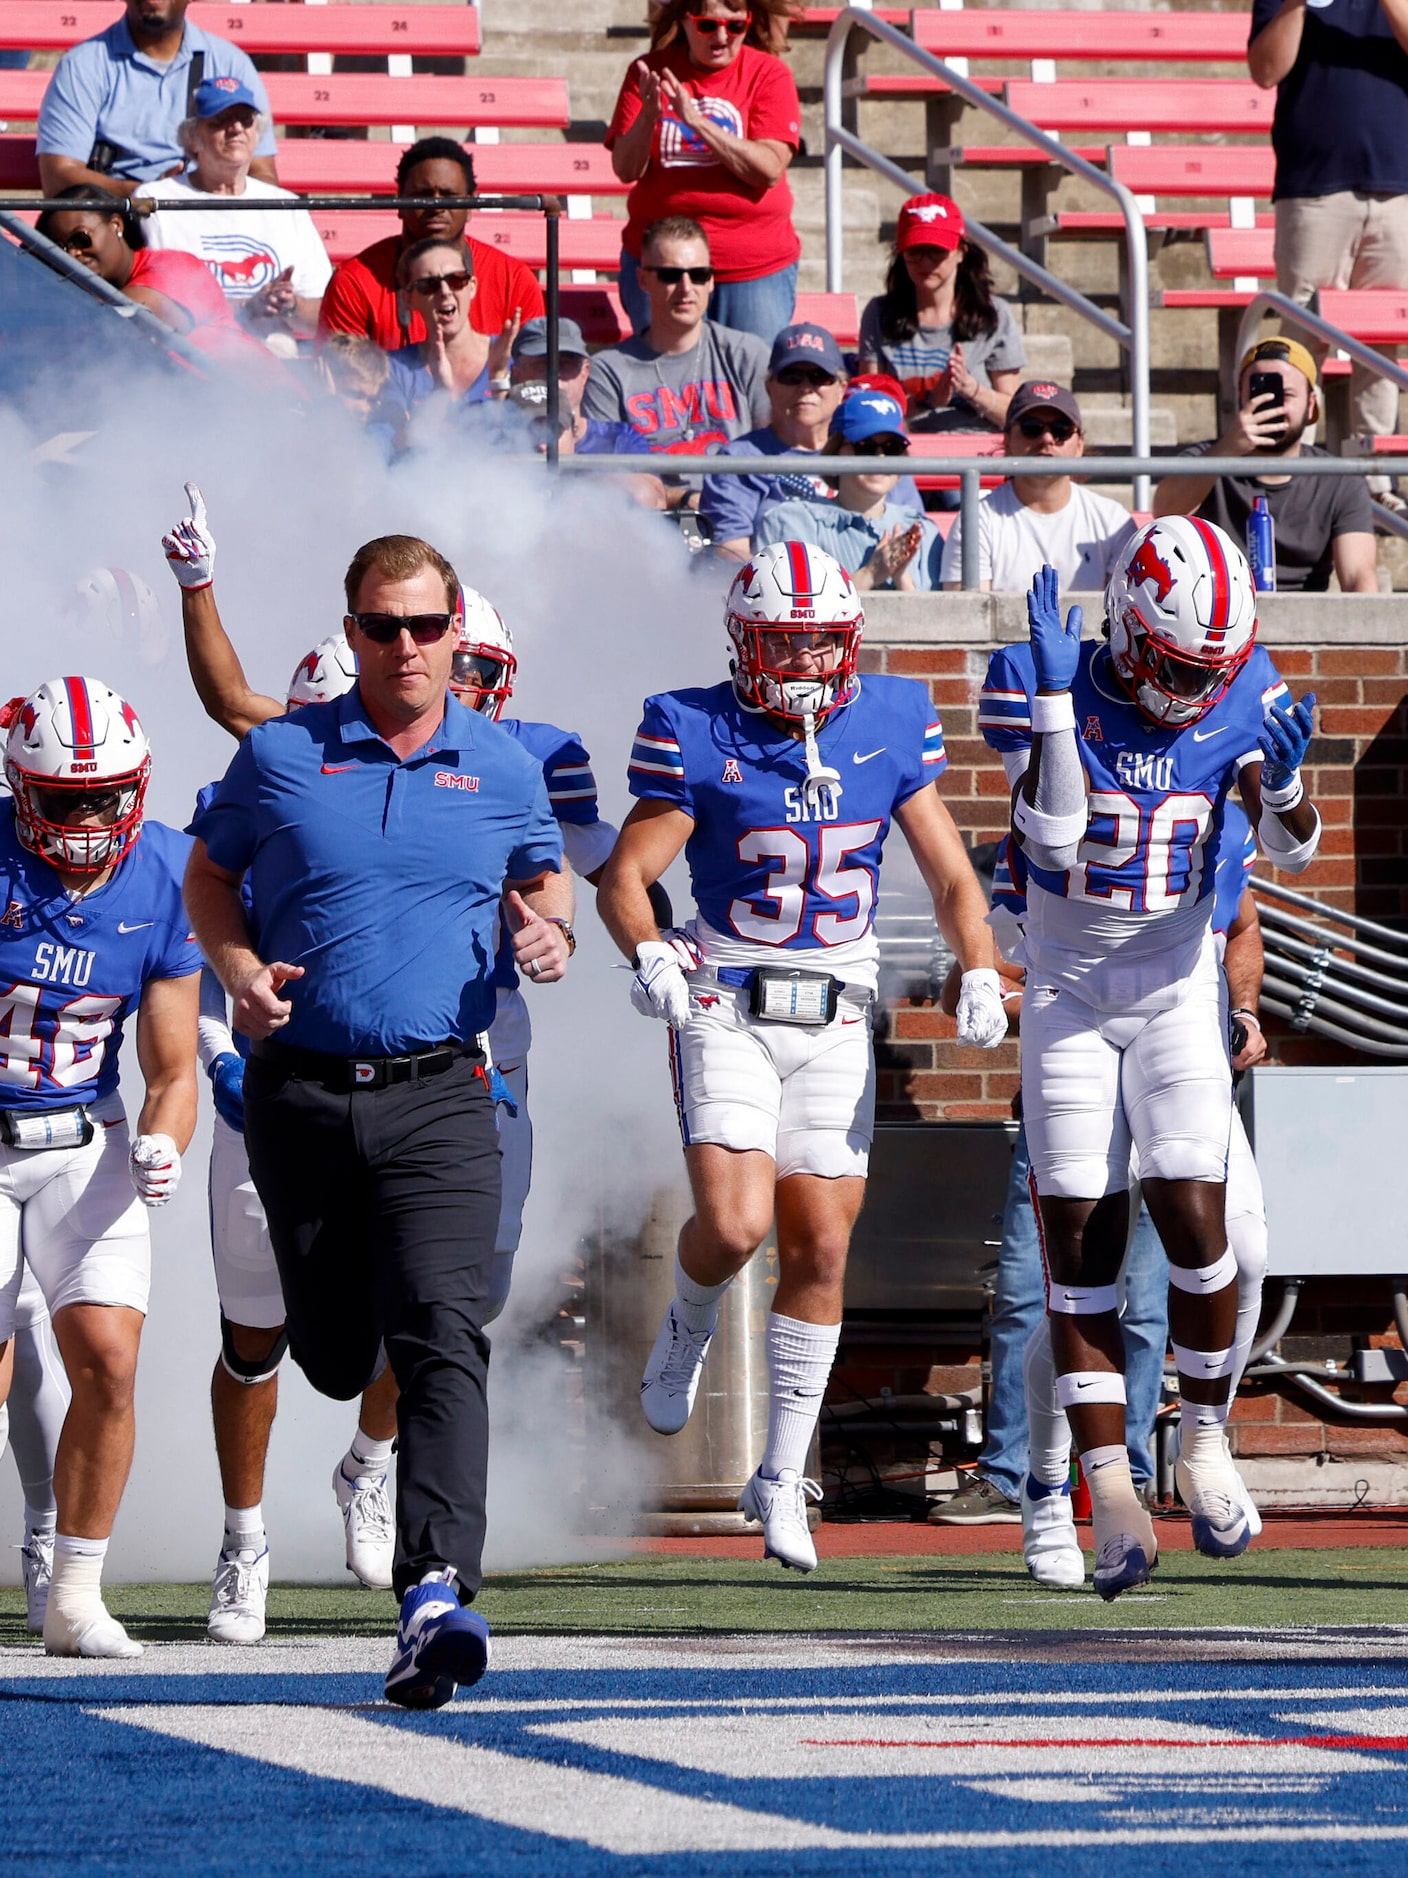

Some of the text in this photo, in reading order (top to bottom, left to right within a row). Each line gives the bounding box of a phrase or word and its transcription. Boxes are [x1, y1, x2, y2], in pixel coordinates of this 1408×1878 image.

[60, 16, 77, 27] 22
[227, 19, 244, 30] 23
[313, 90, 330, 102] 22
[573, 160, 590, 172] 23
[787, 335, 825, 353] USA
[625, 379, 738, 436] SMU
[791, 609, 816, 619] SMU
[1200, 645, 1227, 656] SMU
[70, 762, 98, 773] SMU
[1116, 752, 1175, 791] SMU
[434, 771, 480, 793] SMU
[1064, 789, 1217, 914] 20
[727, 818, 885, 949] 35
[31, 942, 97, 987] SMU
